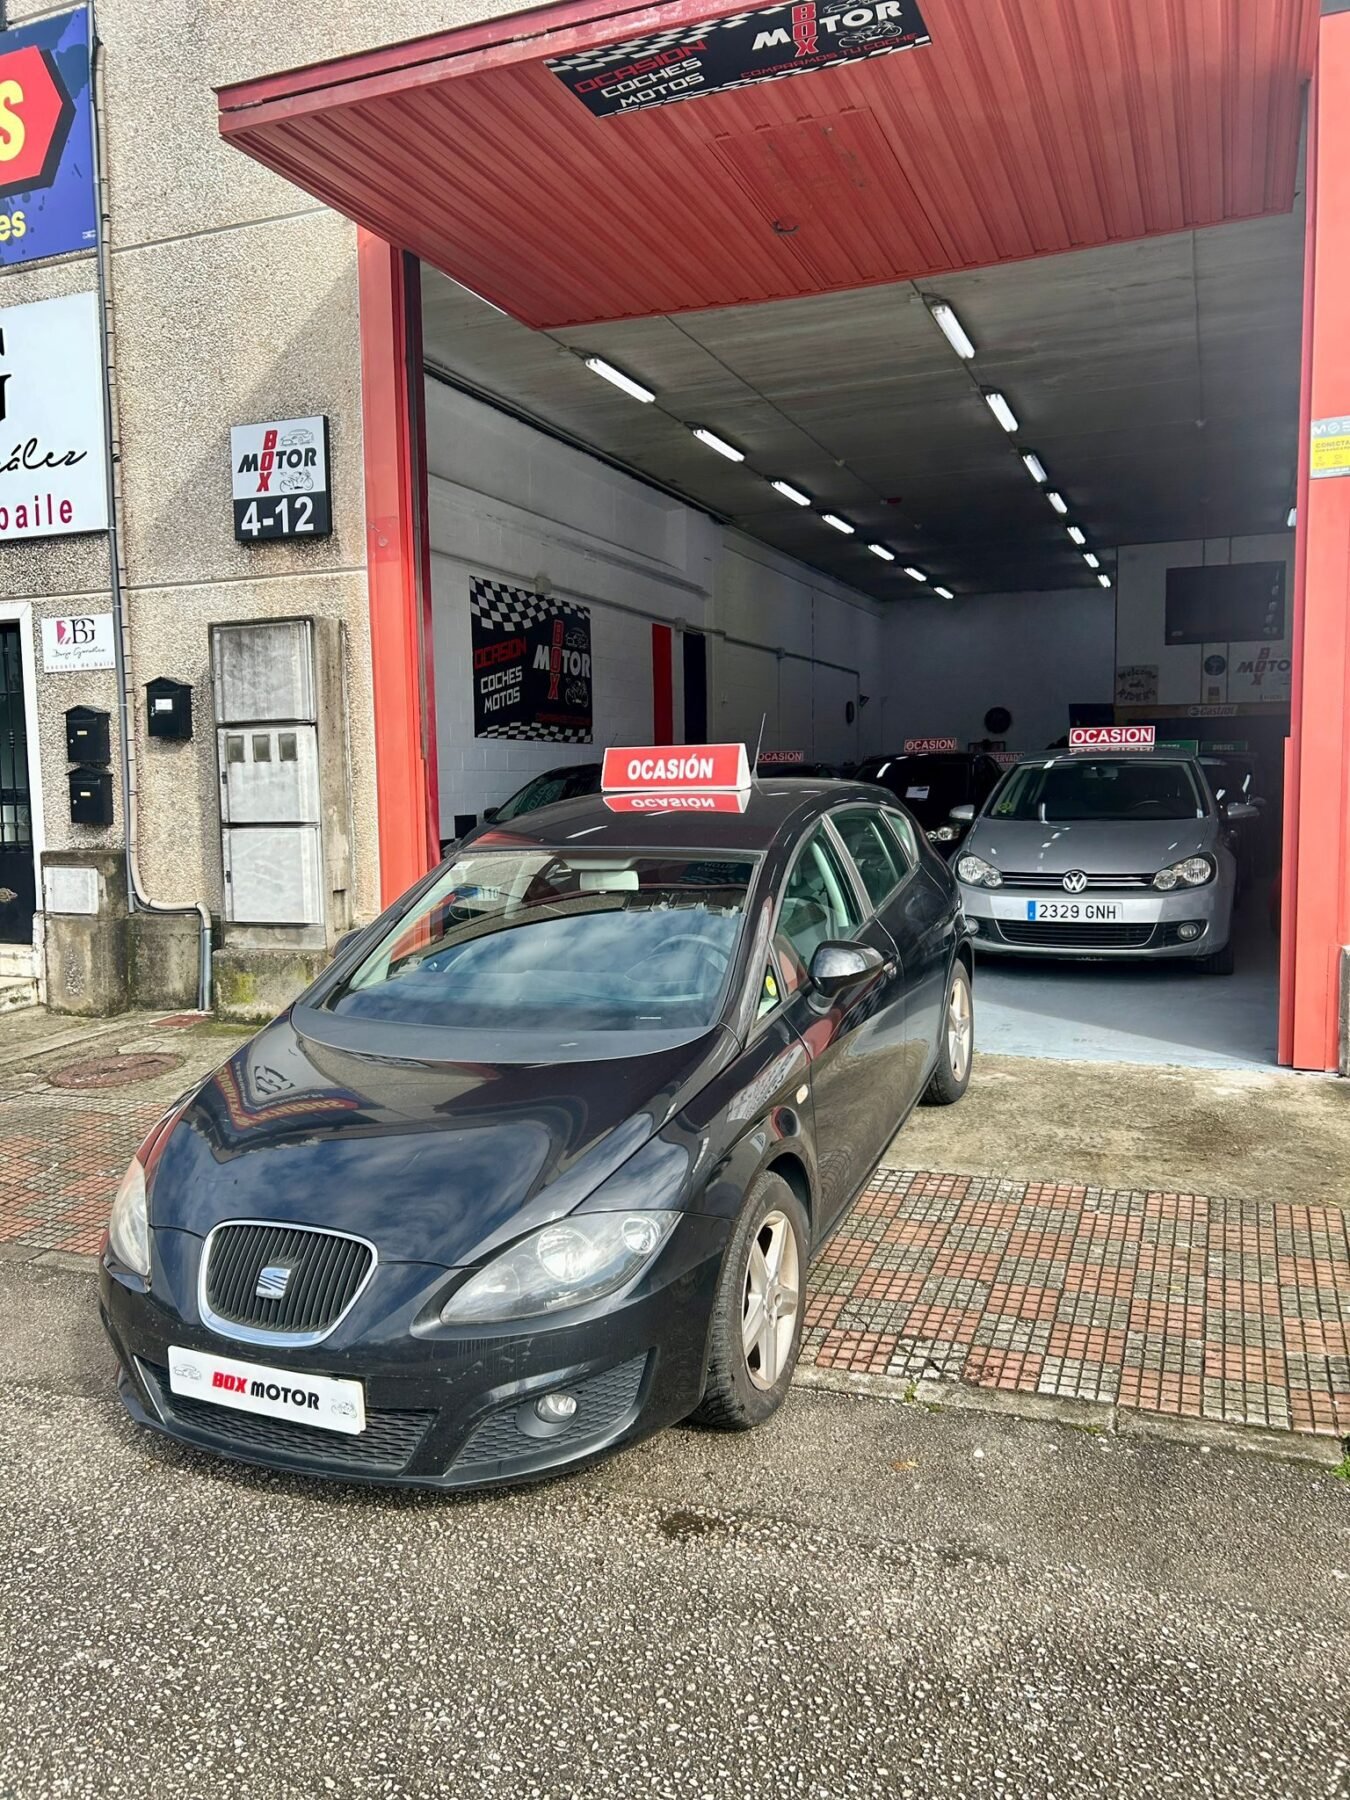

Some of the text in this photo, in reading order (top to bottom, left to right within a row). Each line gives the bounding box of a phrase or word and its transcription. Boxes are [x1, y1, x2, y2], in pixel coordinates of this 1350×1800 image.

[751, 0, 904, 51] MOTOR
[791, 1, 820, 58] BOX
[574, 39, 707, 94] OCASION
[740, 32, 919, 80] COMPRAMOS TU COCHE
[600, 57, 703, 98] COCHES
[620, 72, 705, 108] MOTOS
[238, 447, 317, 474] MOTOR
[256, 429, 278, 493] BOX
[241, 495, 314, 536] 4-12
[473, 636, 528, 671] OCASION
[532, 644, 591, 678] MOTOR
[547, 618, 564, 700] BOX
[480, 665, 523, 694] COCHES
[484, 686, 521, 714] MOTOS
[905, 740, 954, 750] OCASION
[1072, 728, 1152, 743] OCASION
[627, 753, 714, 780] OCASIÓN
[1039, 904, 1116, 920] 2329 GNH
[212, 1371, 320, 1411] BOX MOTOR
